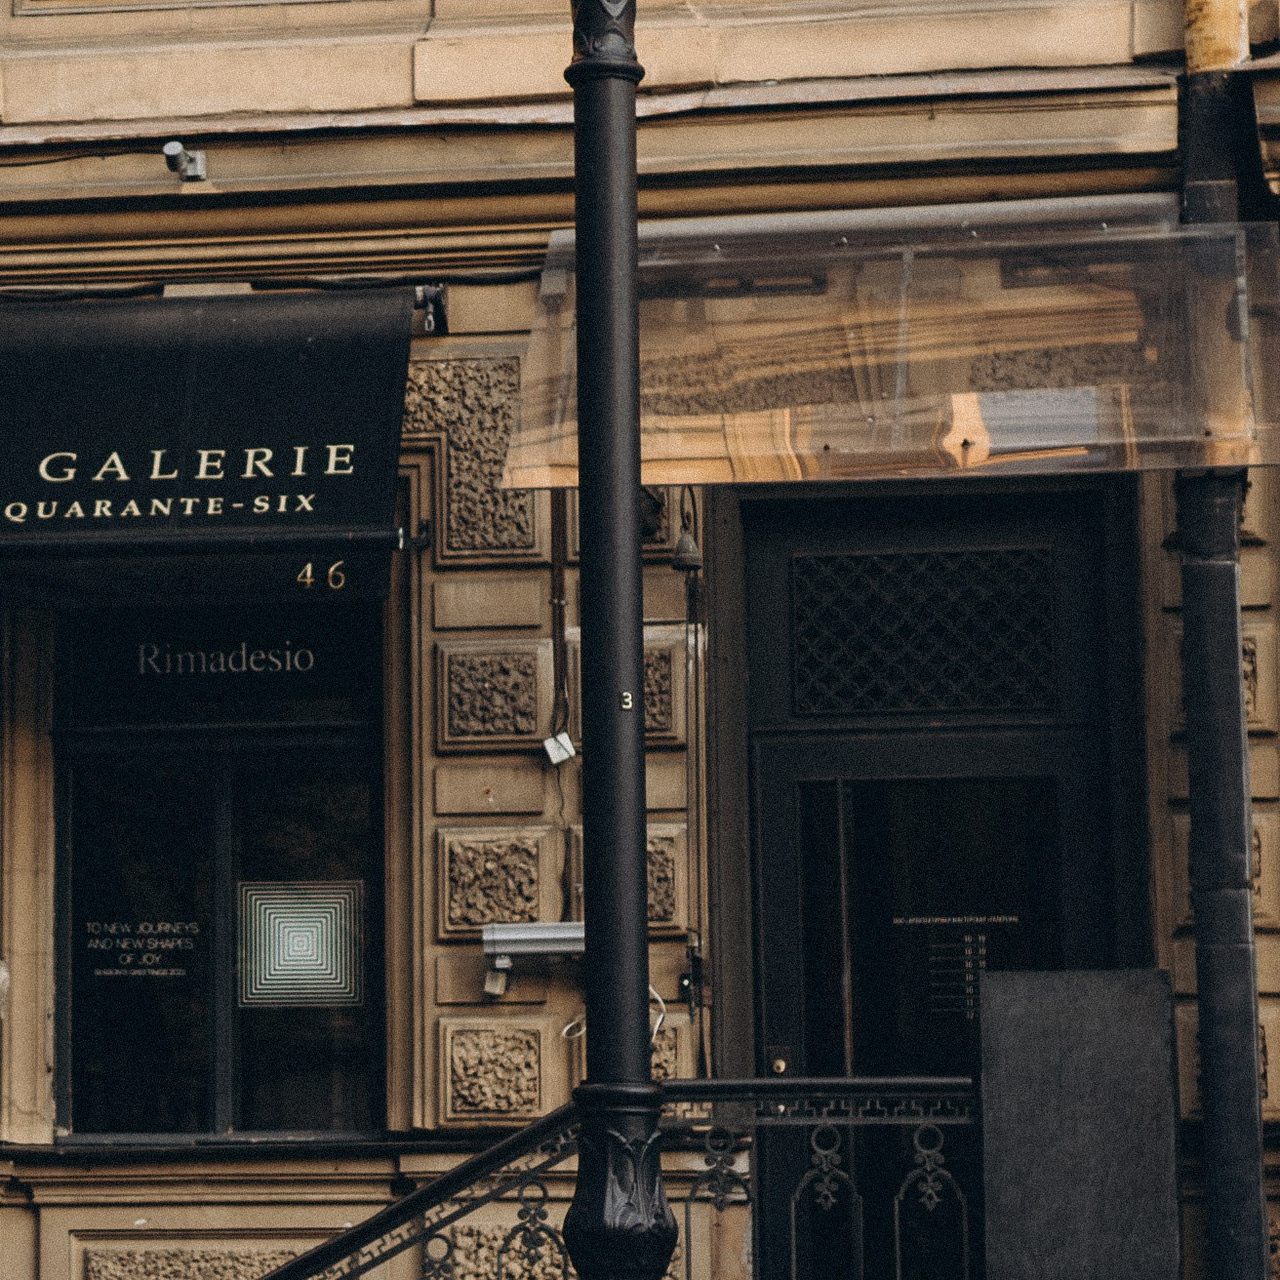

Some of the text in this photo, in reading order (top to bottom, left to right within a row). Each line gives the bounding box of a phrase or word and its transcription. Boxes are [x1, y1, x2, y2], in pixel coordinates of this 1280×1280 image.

[38, 443, 355, 483] GALERIE
[4, 494, 315, 523] QUARANTE-SIX
[297, 560, 346, 589] 46
[138, 640, 315, 675] Rimadesio
[621, 691, 633, 709] 3
